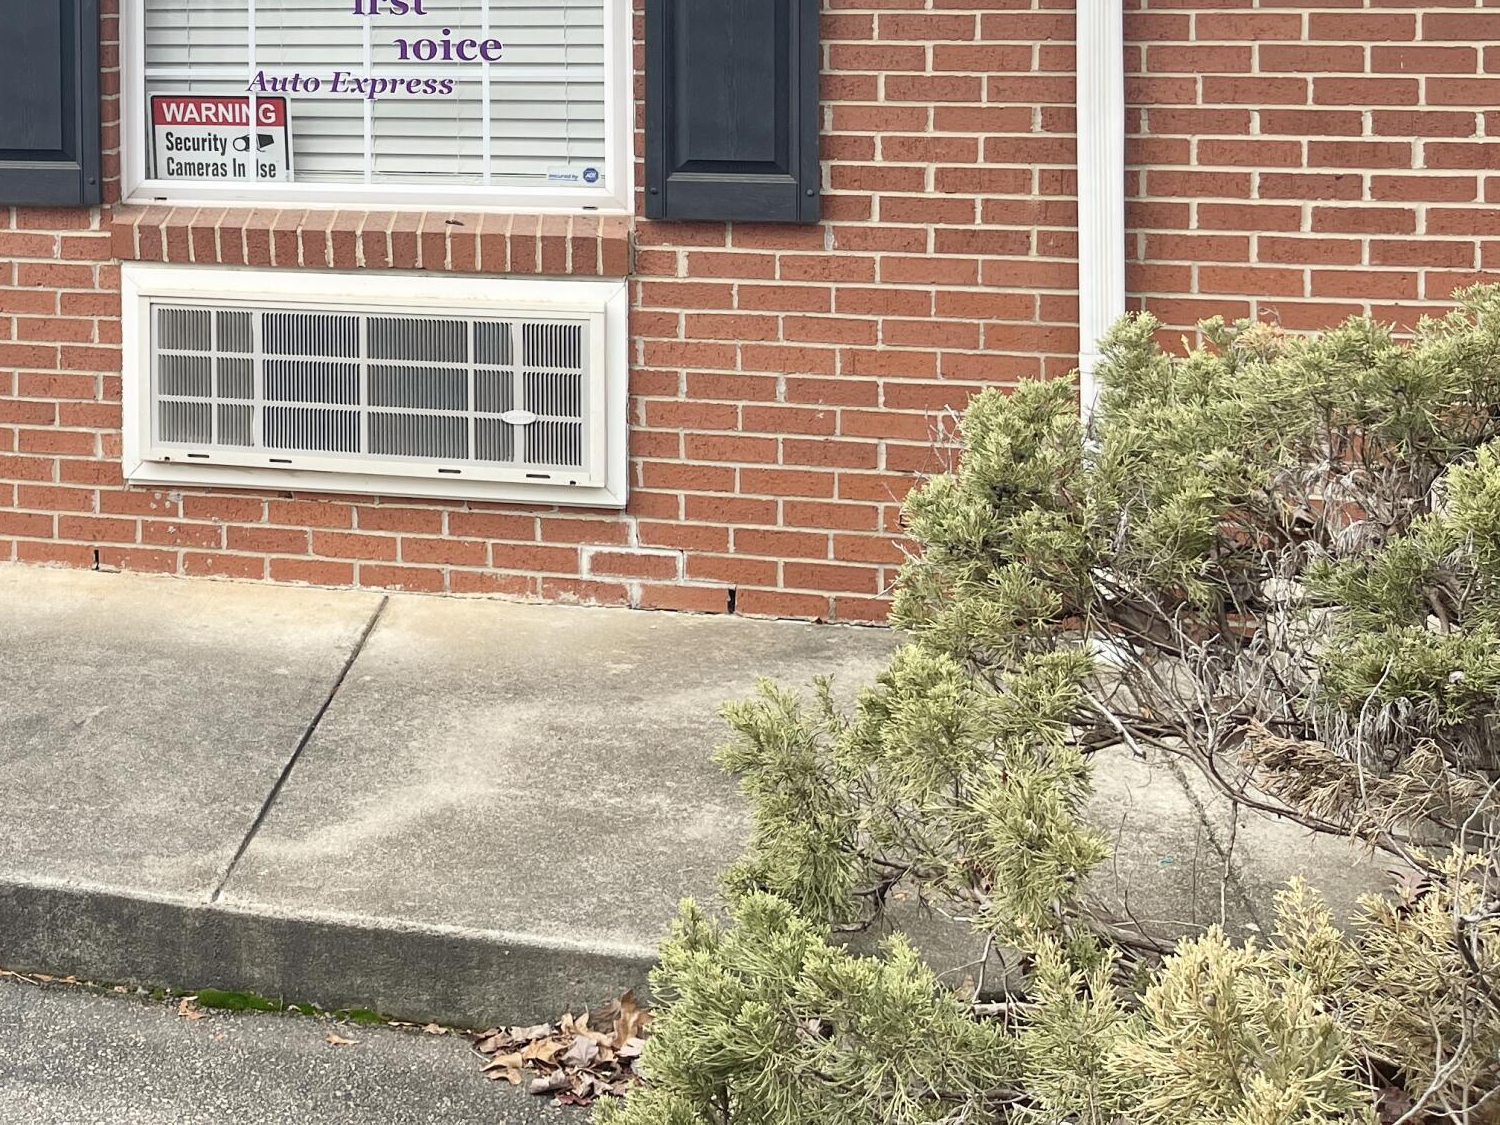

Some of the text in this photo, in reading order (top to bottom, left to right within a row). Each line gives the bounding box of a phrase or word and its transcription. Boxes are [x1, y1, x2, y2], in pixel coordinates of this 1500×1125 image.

[245, 69, 456, 101] Auto Express
[165, 131, 228, 157] Security
[166, 156, 277, 179] Cameras In se
